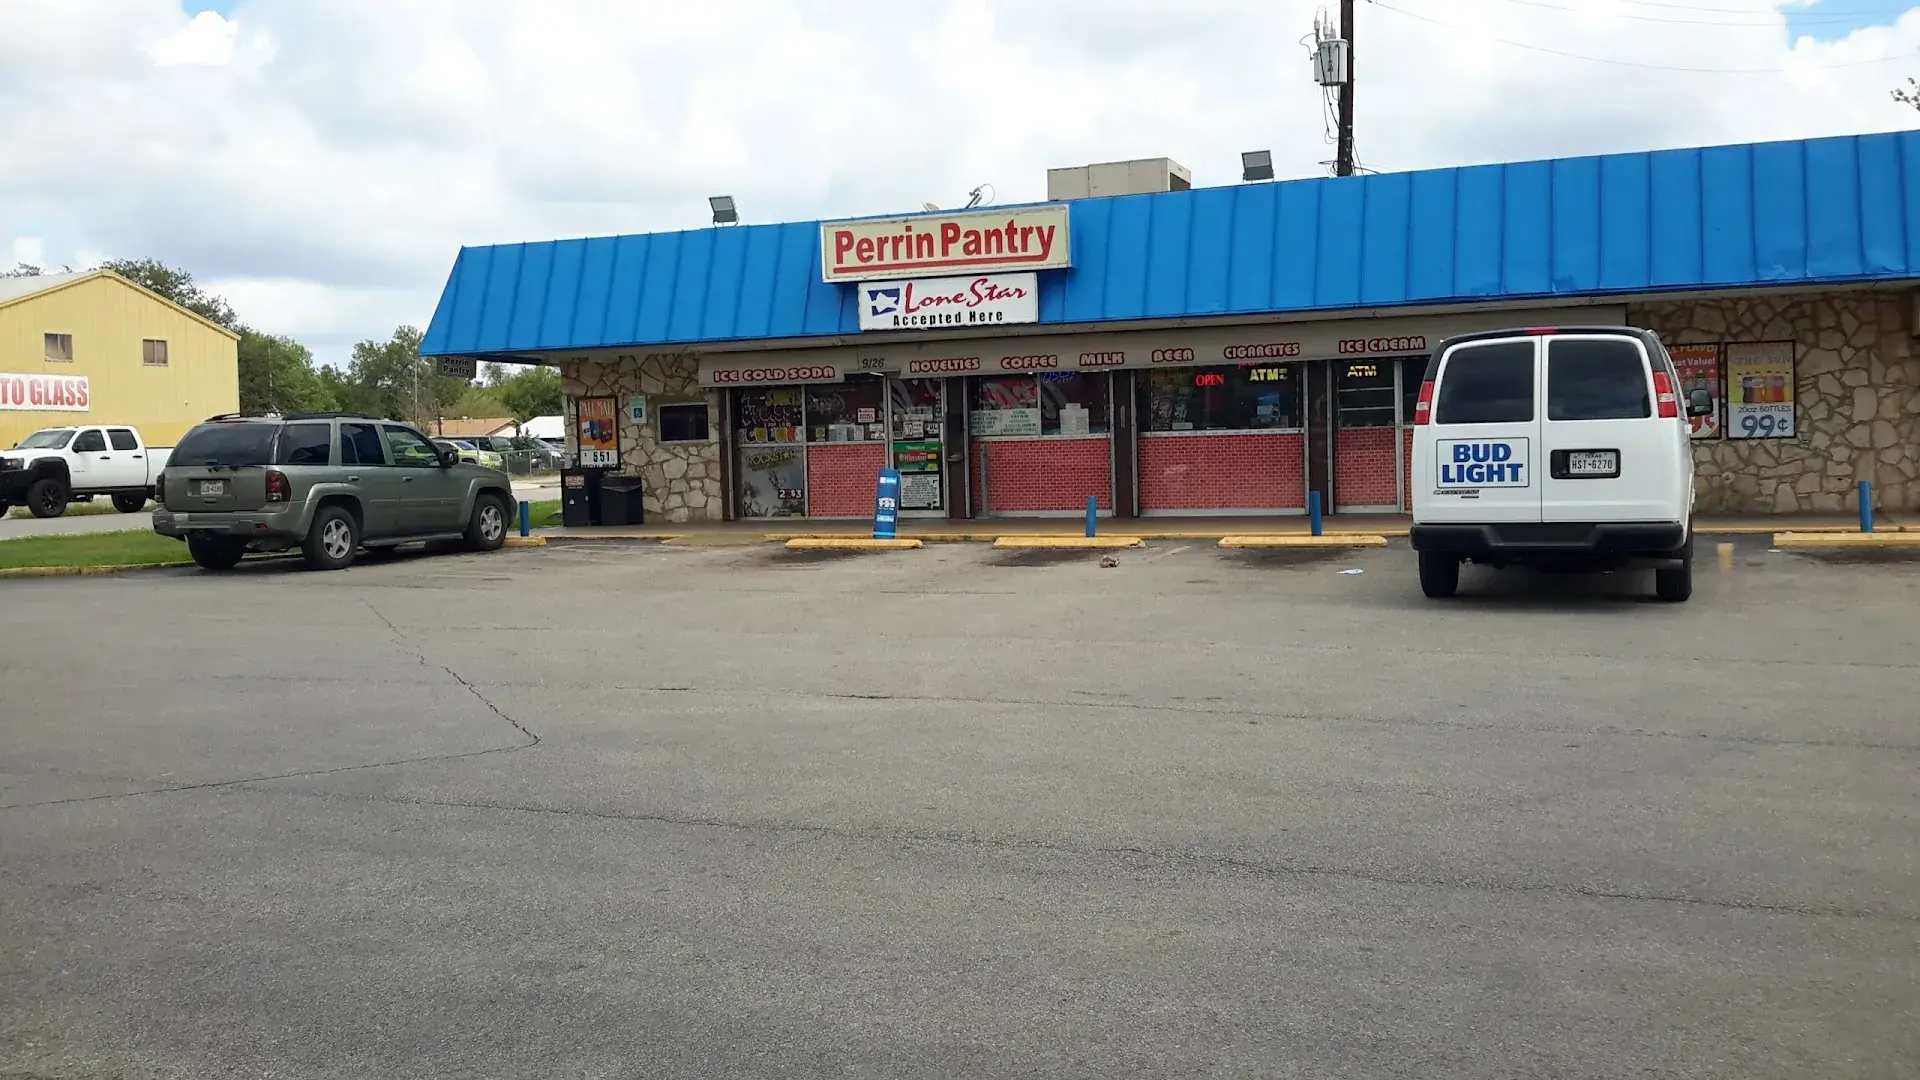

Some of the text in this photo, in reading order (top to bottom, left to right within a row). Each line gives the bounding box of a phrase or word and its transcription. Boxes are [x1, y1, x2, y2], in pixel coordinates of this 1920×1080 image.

[835, 219, 1056, 265] Perrin Pantry
[893, 310, 1003, 327] Accepted Here
[1223, 342, 1300, 360] CIGARETTES
[1339, 336, 1426, 354] ICE CREAM
[444, 357, 469, 366] Perrin
[1001, 355, 1058, 369] COFFEE
[1080, 352, 1124, 366] MILK
[1152, 348, 1194, 363] BEER
[1687, 356, 1716, 367] Value!
[443, 365, 470, 376] Pantry
[862, 358, 885, 369] 9/26
[910, 357, 981, 373] NOVELTIES
[713, 366, 835, 382] ICE COLD SODA
[1249, 368, 1279, 381] ATM
[1346, 365, 1378, 377] ATM
[1195, 374, 1225, 387] OPEN
[30, 379, 88, 406] GLASS
[1453, 443, 1512, 463] BUD
[1442, 463, 1524, 483] LIGHT
[779, 490, 786, 498] 2
